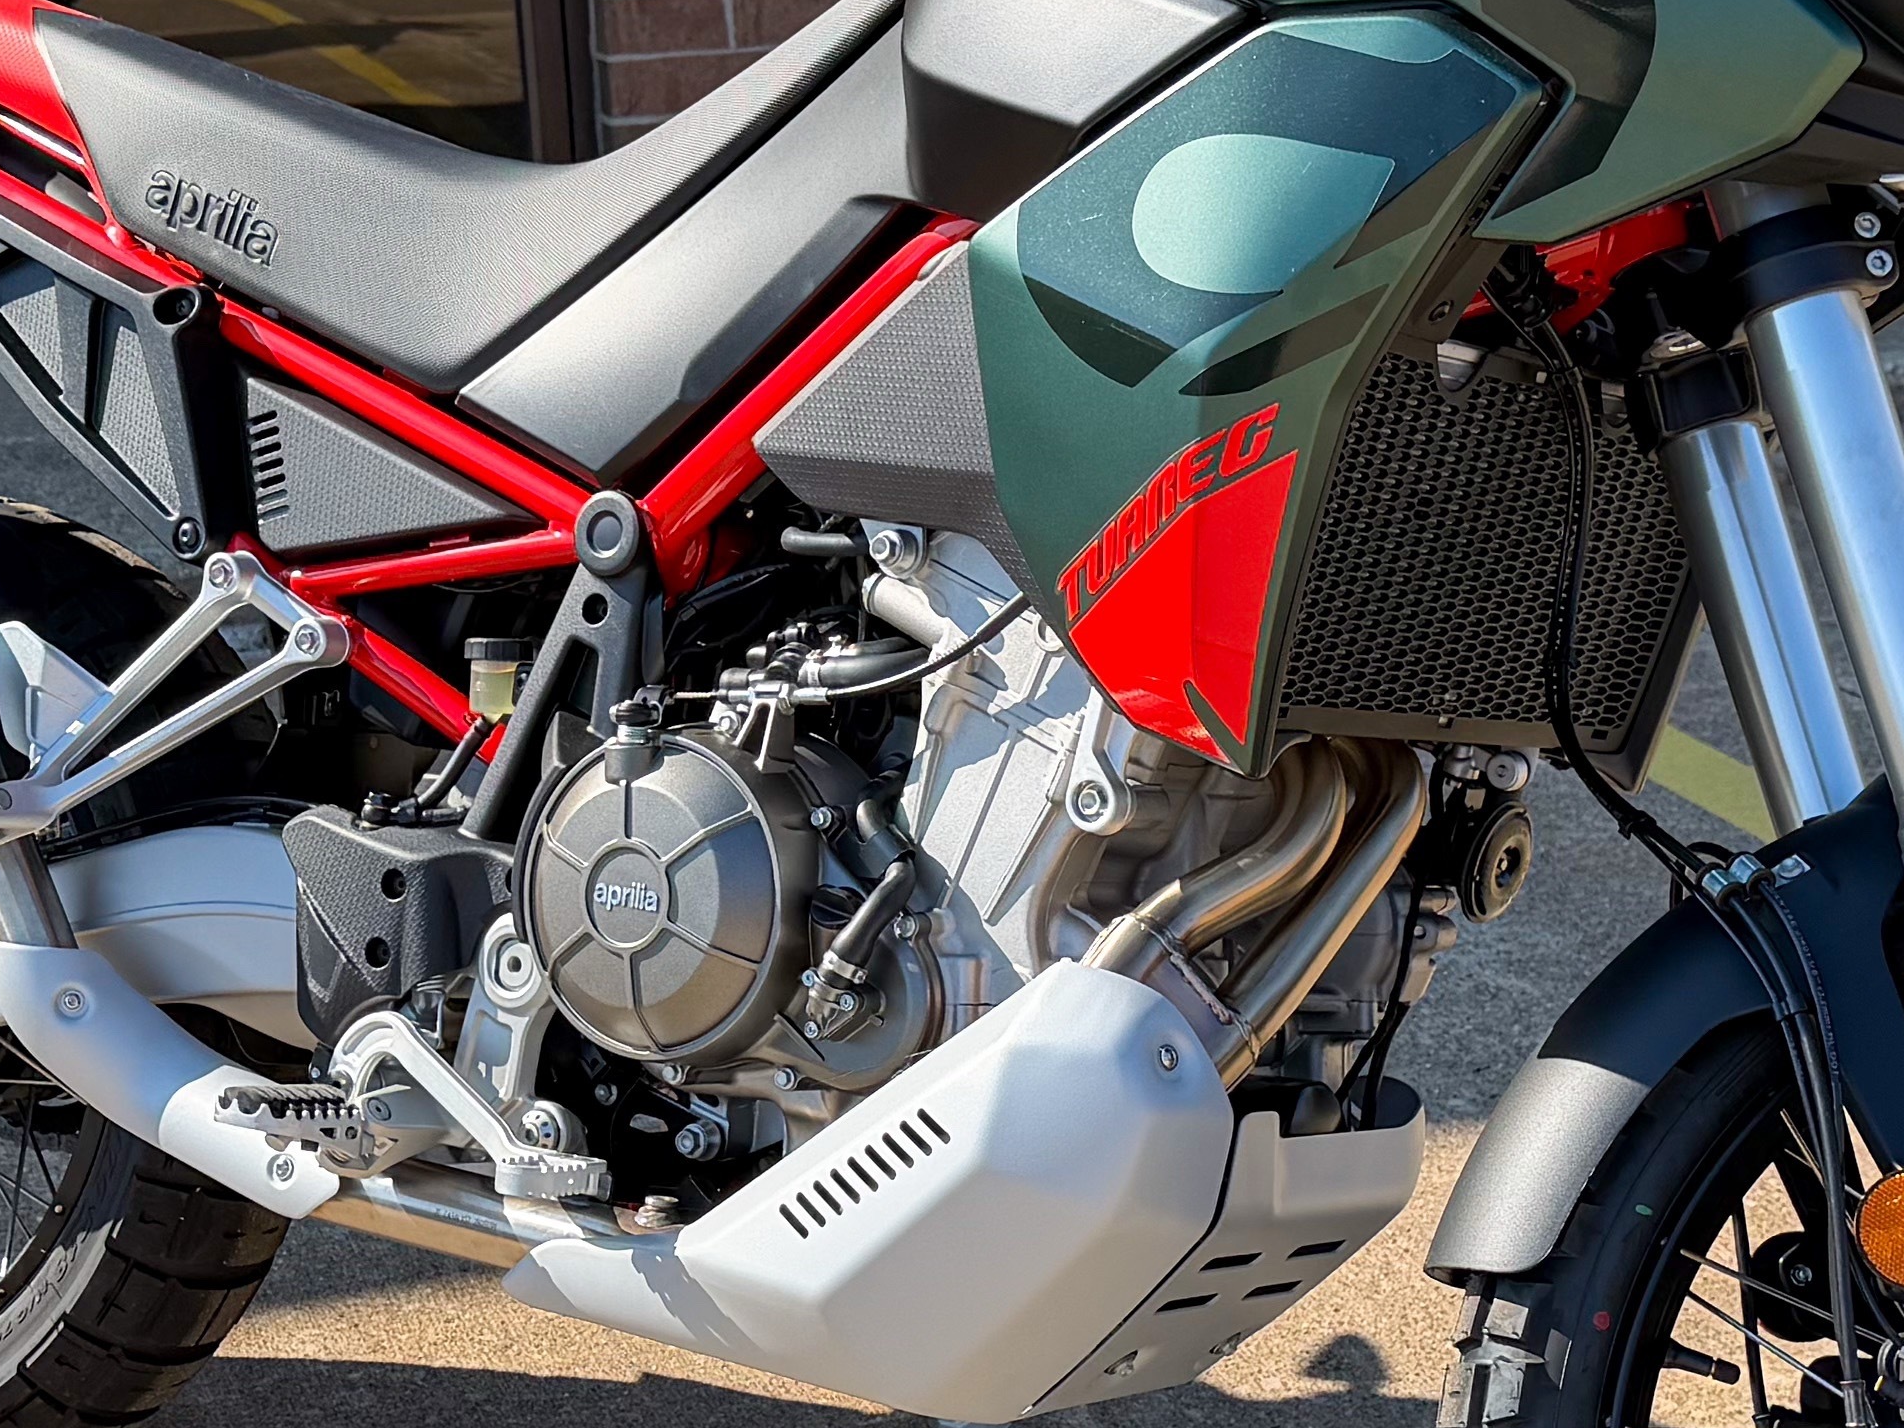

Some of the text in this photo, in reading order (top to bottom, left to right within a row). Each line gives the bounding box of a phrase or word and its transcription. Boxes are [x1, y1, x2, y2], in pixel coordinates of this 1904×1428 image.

[144, 168, 280, 268] aprilia
[1056, 402, 1280, 622] TUAREG
[593, 879, 661, 912] aprilia
